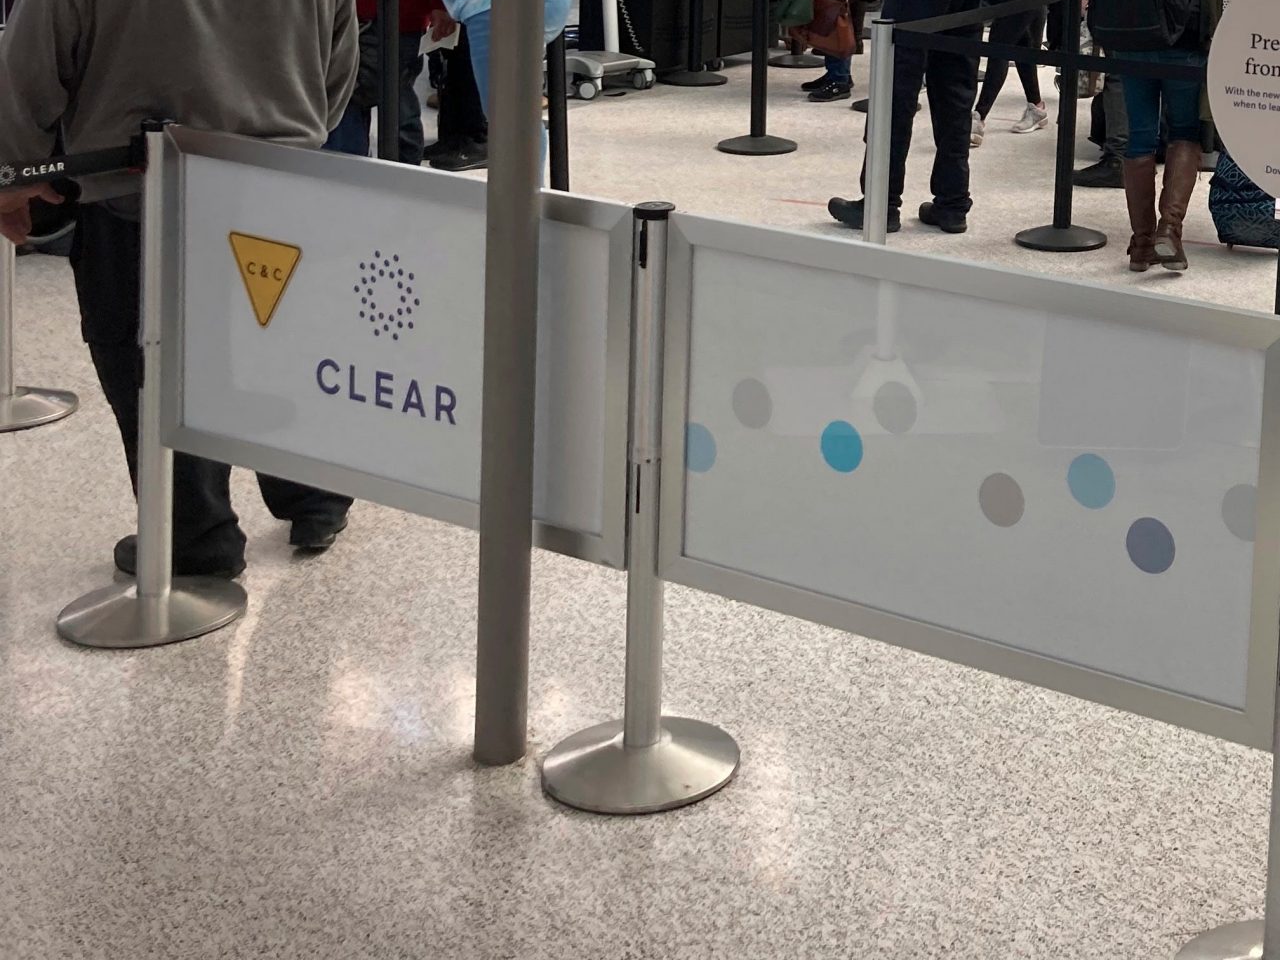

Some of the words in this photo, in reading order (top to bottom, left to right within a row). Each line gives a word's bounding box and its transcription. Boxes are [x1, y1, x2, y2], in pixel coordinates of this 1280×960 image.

[1225, 85, 1245, 96] With
[1247, 88, 1260, 97] the
[1262, 91, 1280, 99] new
[1233, 99, 1256, 109] when
[1258, 102, 1267, 110] to
[22, 162, 65, 177] CLEAR
[247, 262, 256, 275] C
[260, 265, 269, 279] &
[273, 268, 282, 281] C
[316, 358, 457, 426] CLEAR
